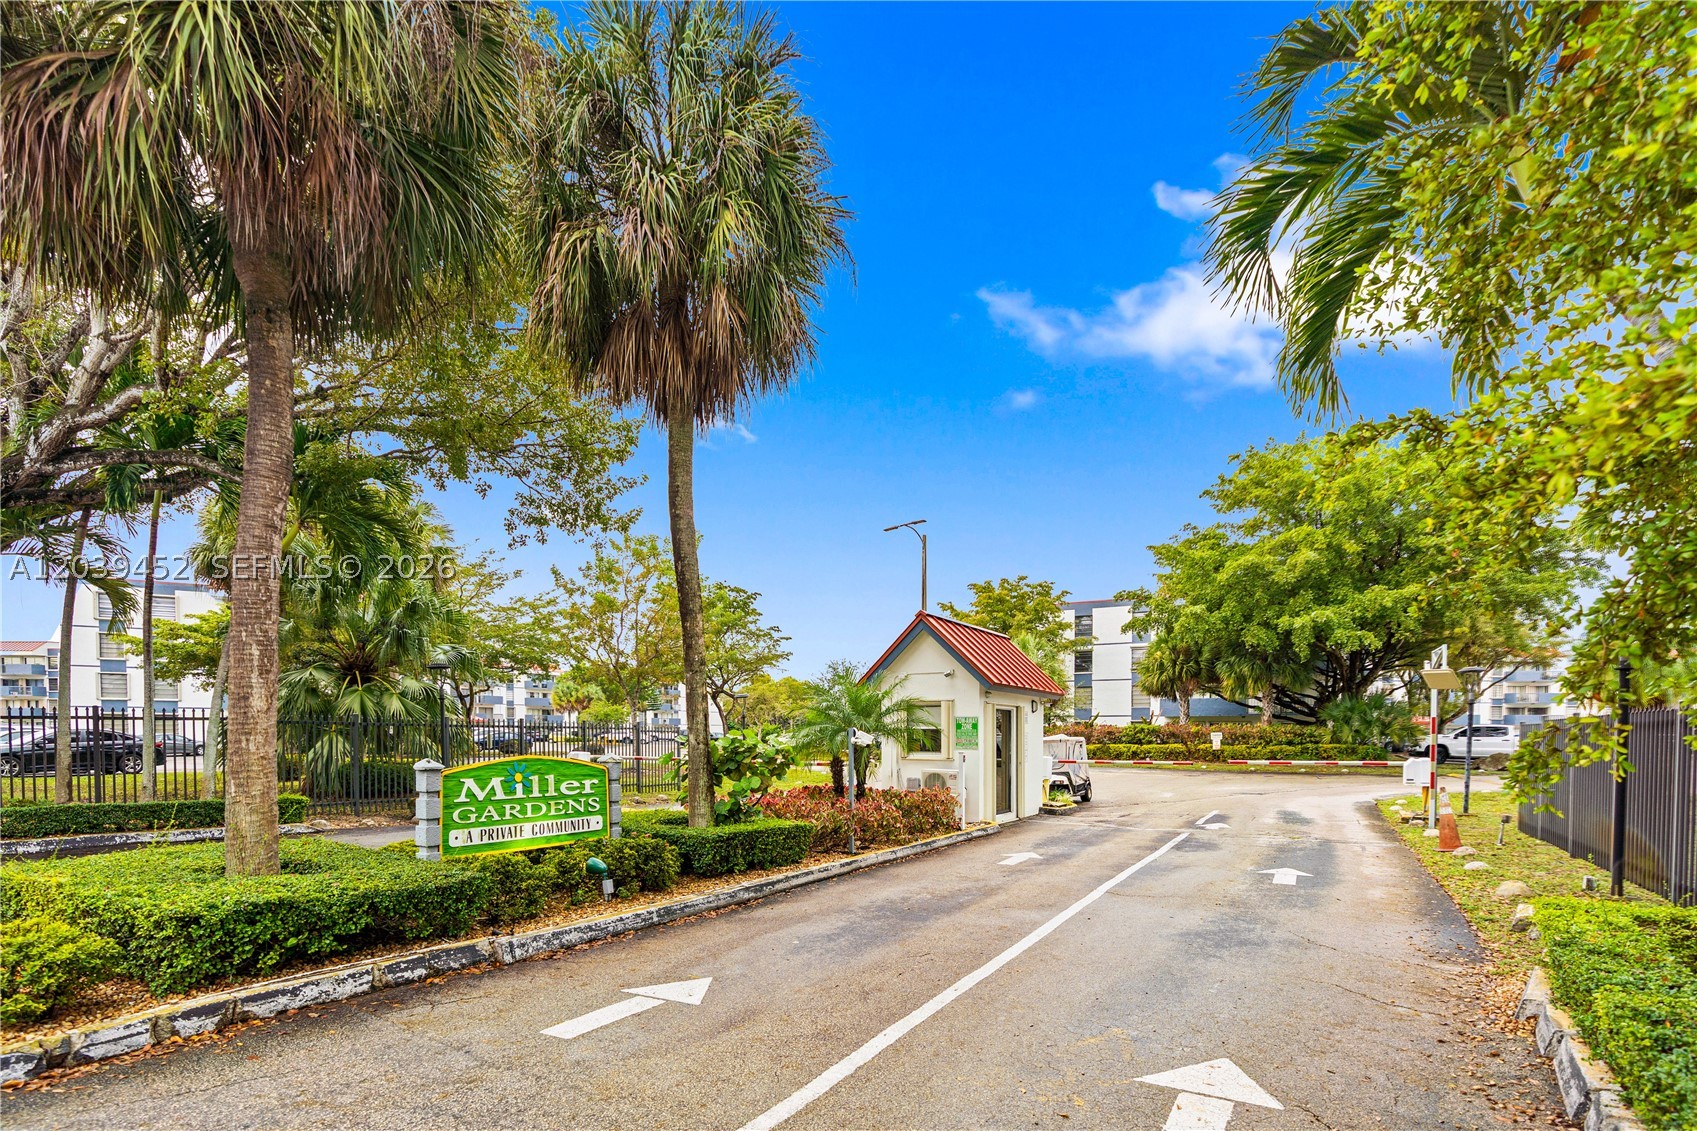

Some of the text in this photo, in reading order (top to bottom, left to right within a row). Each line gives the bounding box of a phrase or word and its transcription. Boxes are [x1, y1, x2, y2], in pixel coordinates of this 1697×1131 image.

[453, 774, 599, 804] Miller
[452, 797, 600, 824] GARDENS
[466, 818, 592, 844] A PRIVATE COMMUNITY
